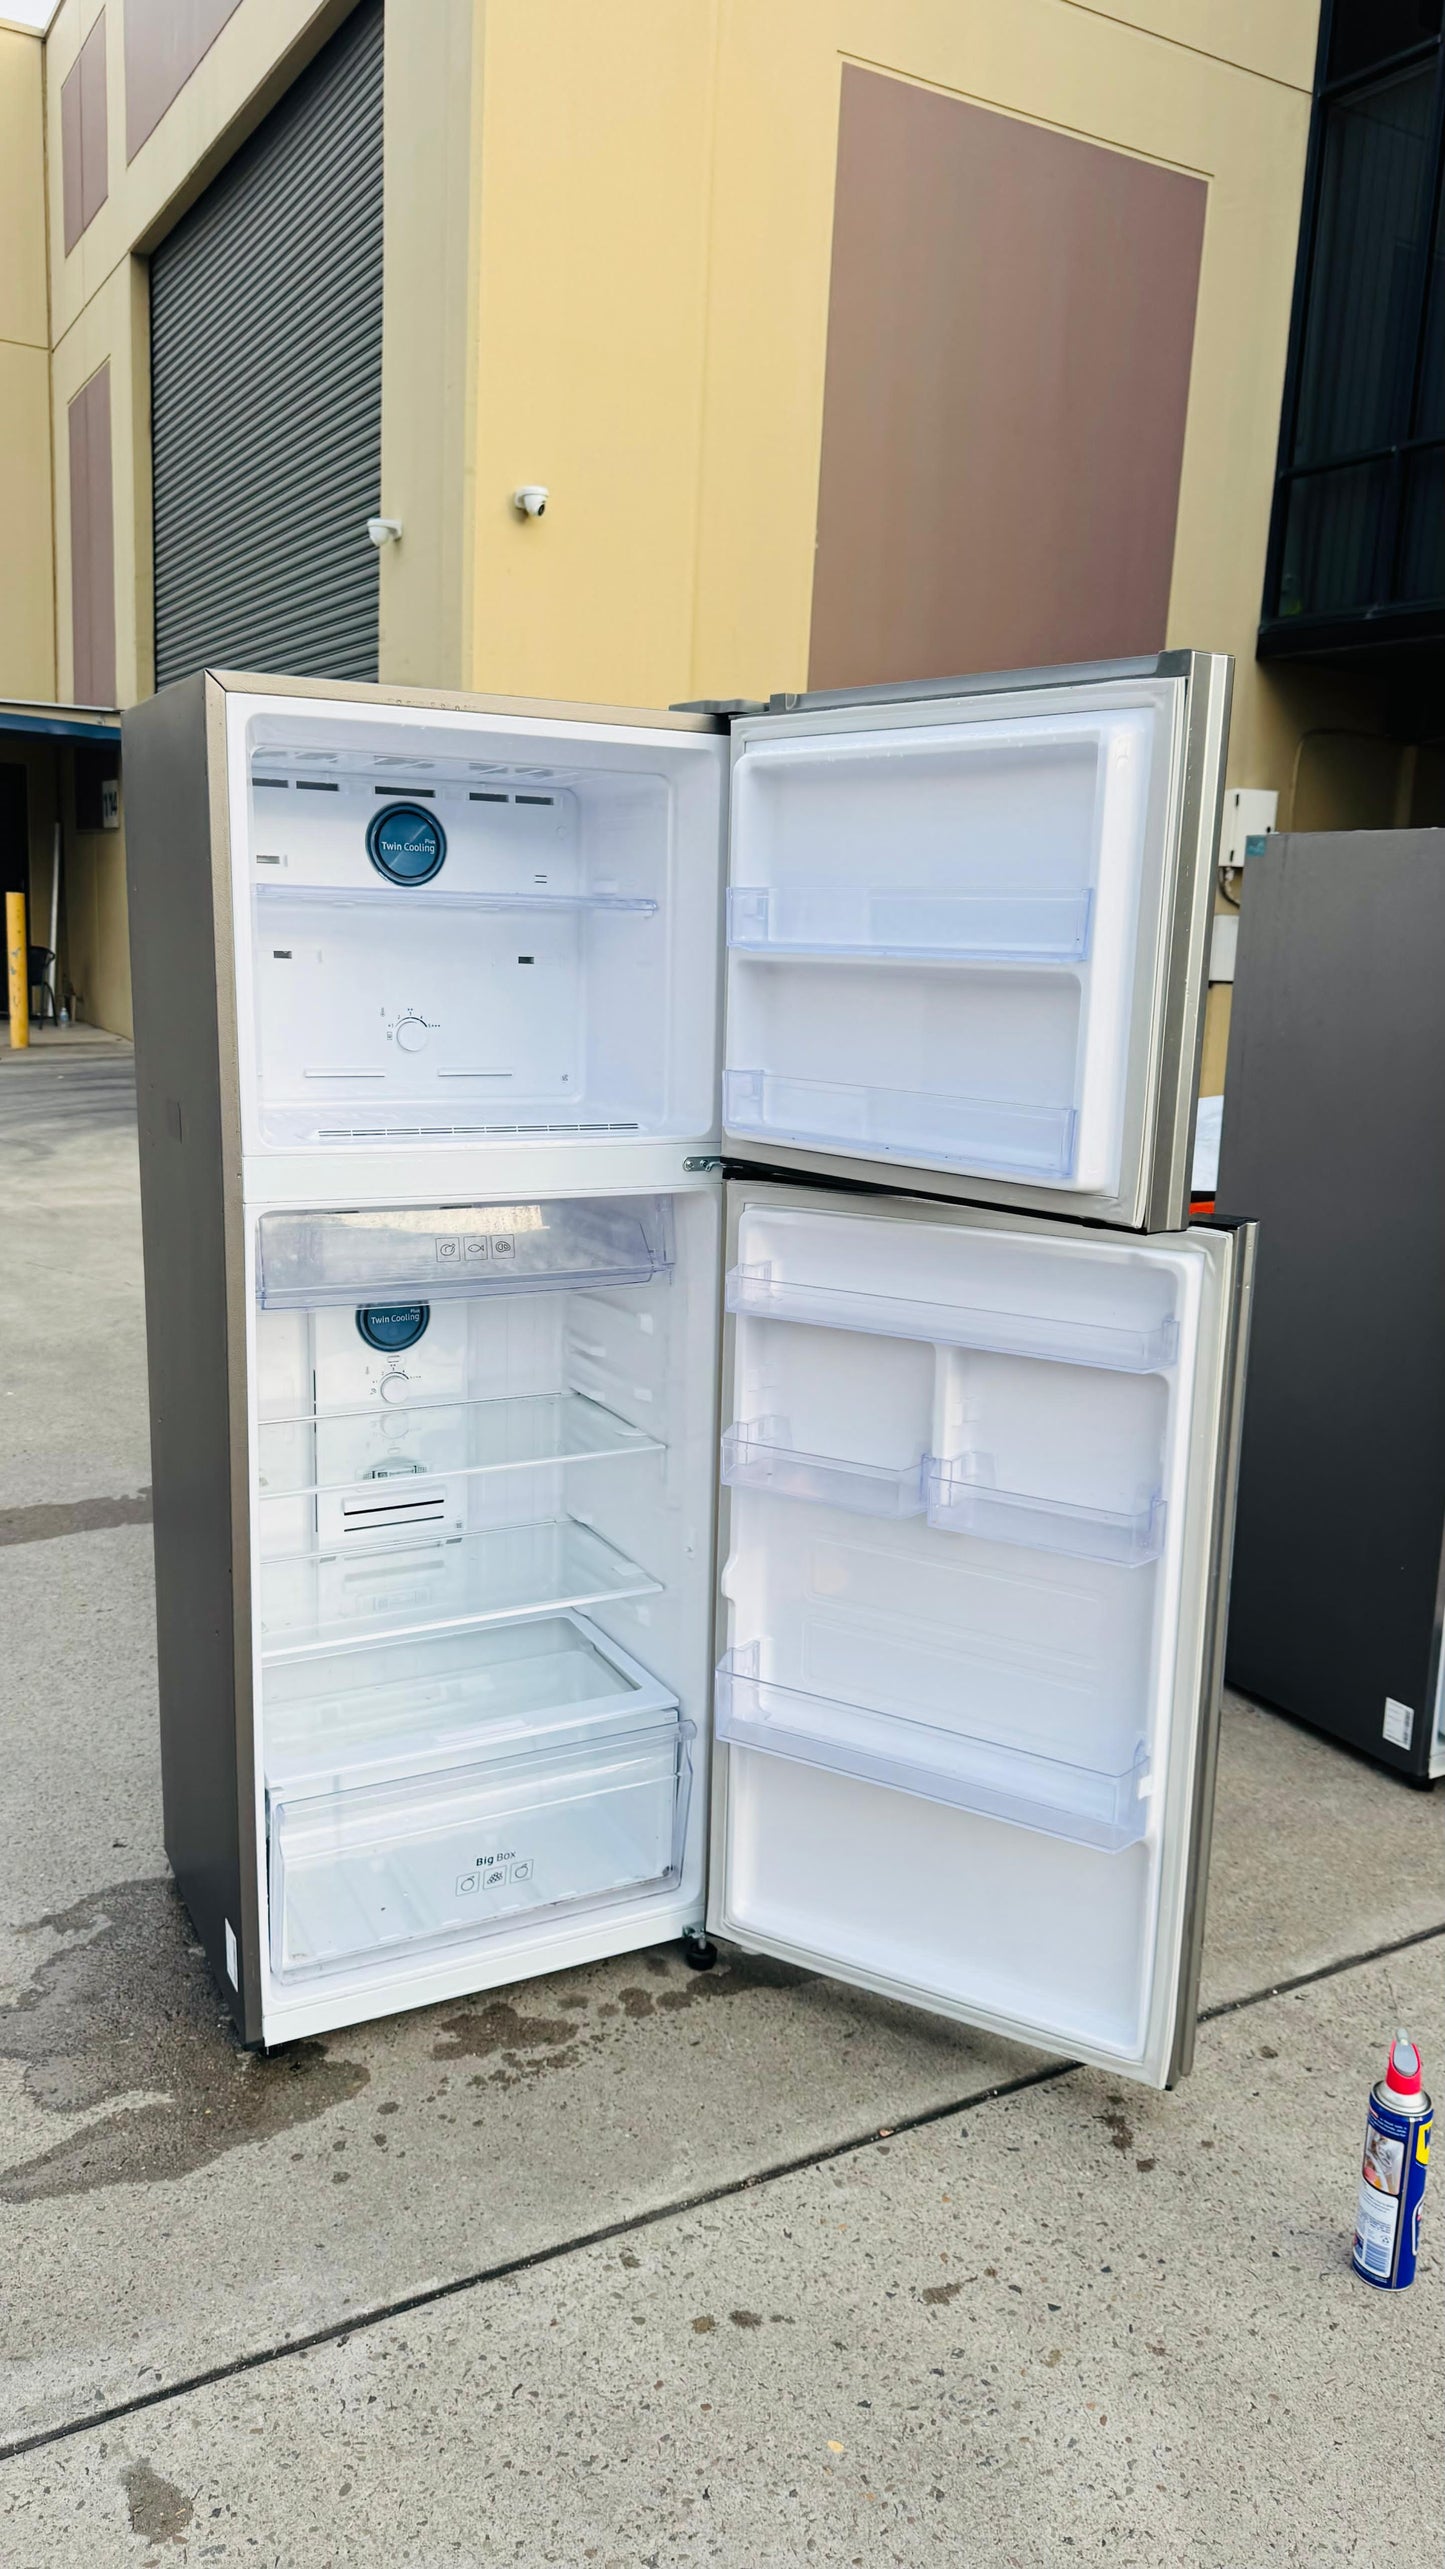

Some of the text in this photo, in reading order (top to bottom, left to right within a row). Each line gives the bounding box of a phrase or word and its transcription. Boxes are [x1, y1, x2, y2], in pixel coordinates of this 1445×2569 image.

[381, 841, 402, 851] Twin
[403, 842, 435, 855] Cooling
[371, 1316, 390, 1324] Twin
[391, 1313, 420, 1322] Cooling
[476, 1851, 516, 1867] Big Box
